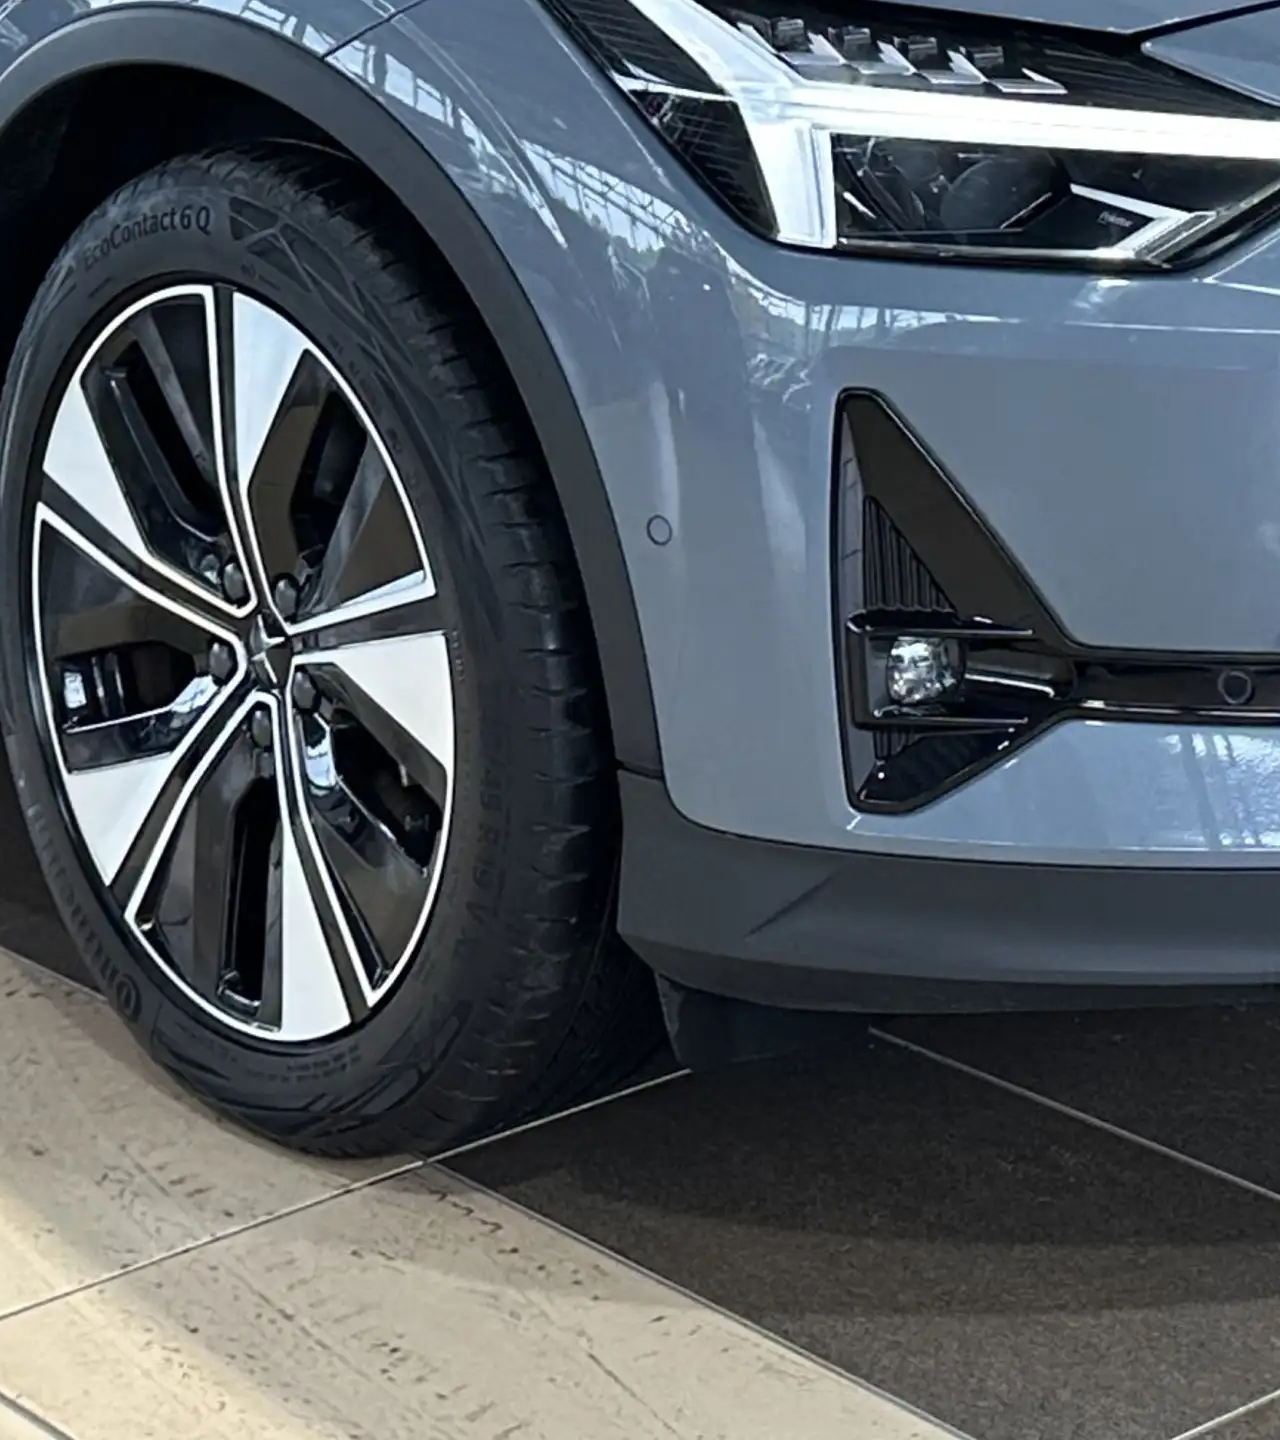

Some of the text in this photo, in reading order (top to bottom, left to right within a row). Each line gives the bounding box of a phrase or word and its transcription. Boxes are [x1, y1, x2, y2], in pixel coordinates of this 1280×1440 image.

[82, 204, 213, 271] EcoContact 6 Q
